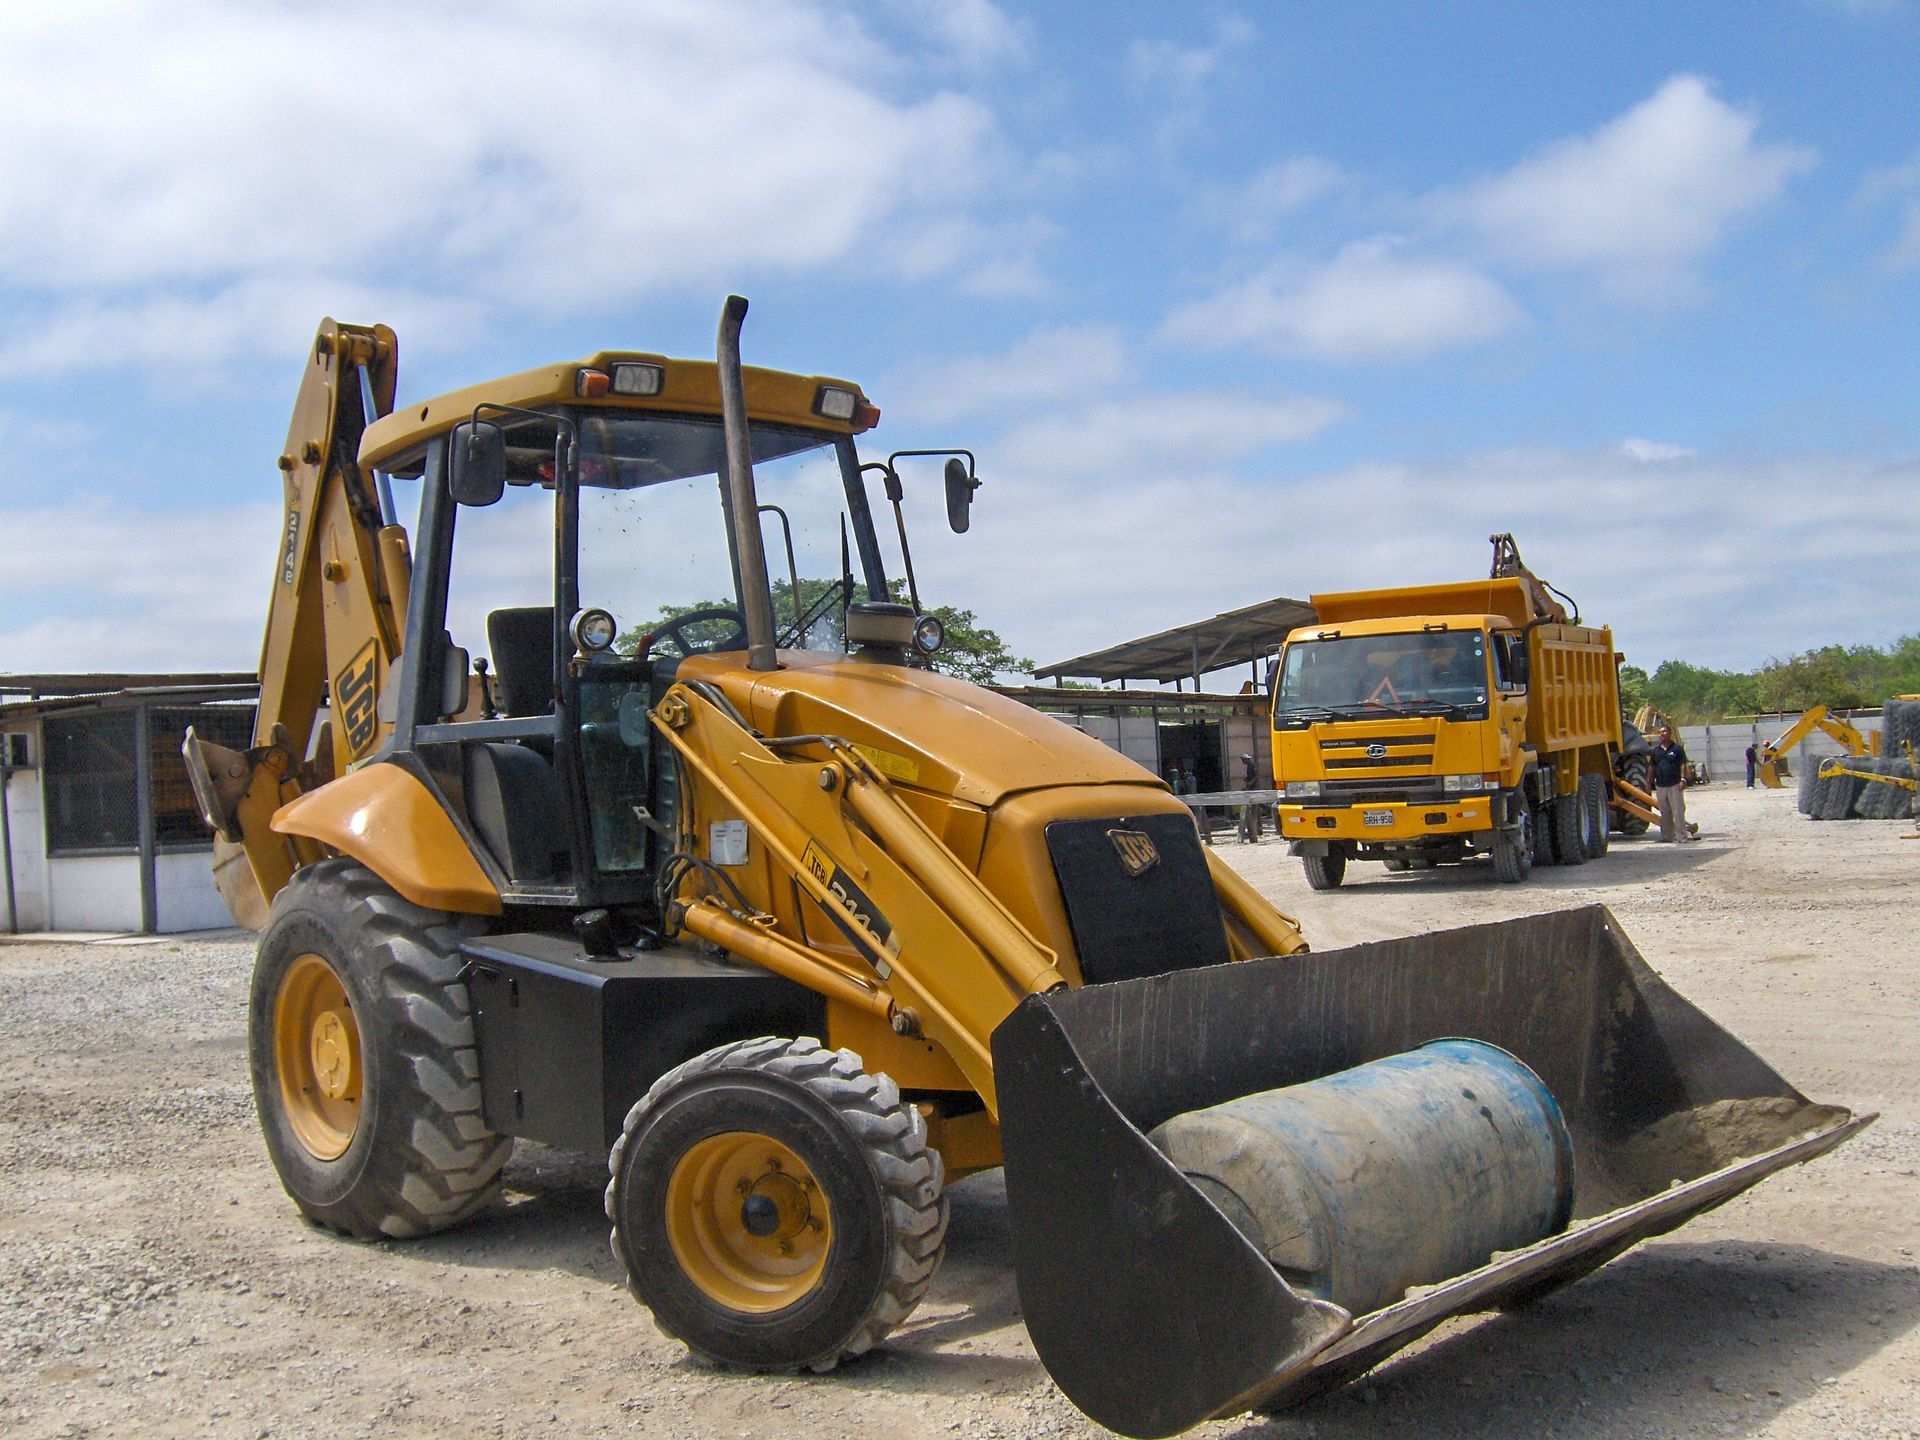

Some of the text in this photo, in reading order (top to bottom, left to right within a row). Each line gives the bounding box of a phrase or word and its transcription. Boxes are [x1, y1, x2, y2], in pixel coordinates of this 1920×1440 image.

[338, 656, 374, 752] JCB
[807, 854, 827, 886] JCB
[1110, 832, 1157, 871] JCB
